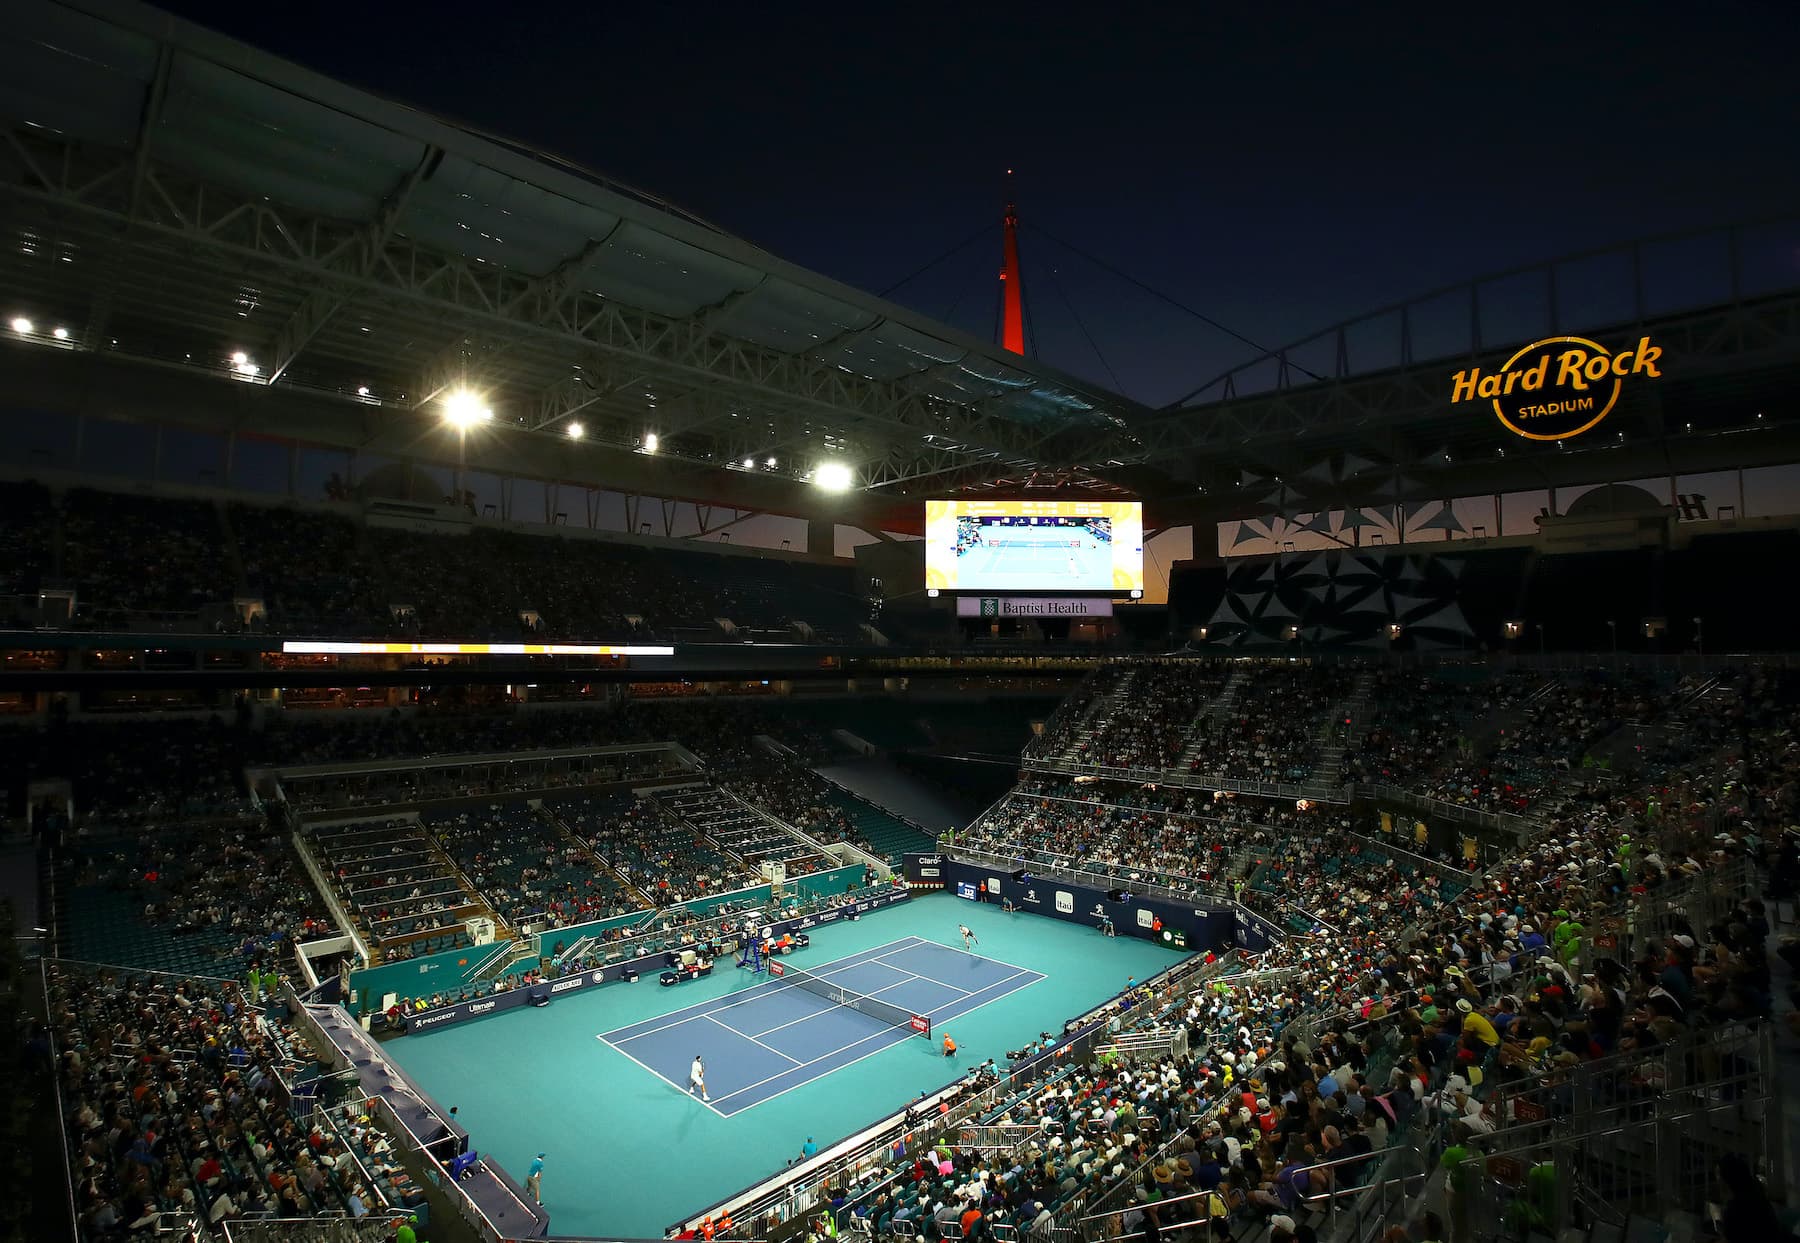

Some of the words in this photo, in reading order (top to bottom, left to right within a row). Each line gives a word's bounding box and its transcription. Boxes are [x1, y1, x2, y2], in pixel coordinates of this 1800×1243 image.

[1451, 355, 1549, 403] Hard
[1556, 336, 1663, 390] Rock
[1518, 397, 1594, 419] STADIUM
[1003, 602, 1044, 616] Baptist
[1048, 602, 1087, 614] Health
[469, 1001, 496, 1013] Ultimate
[422, 1012, 456, 1025] PEUGEOT
